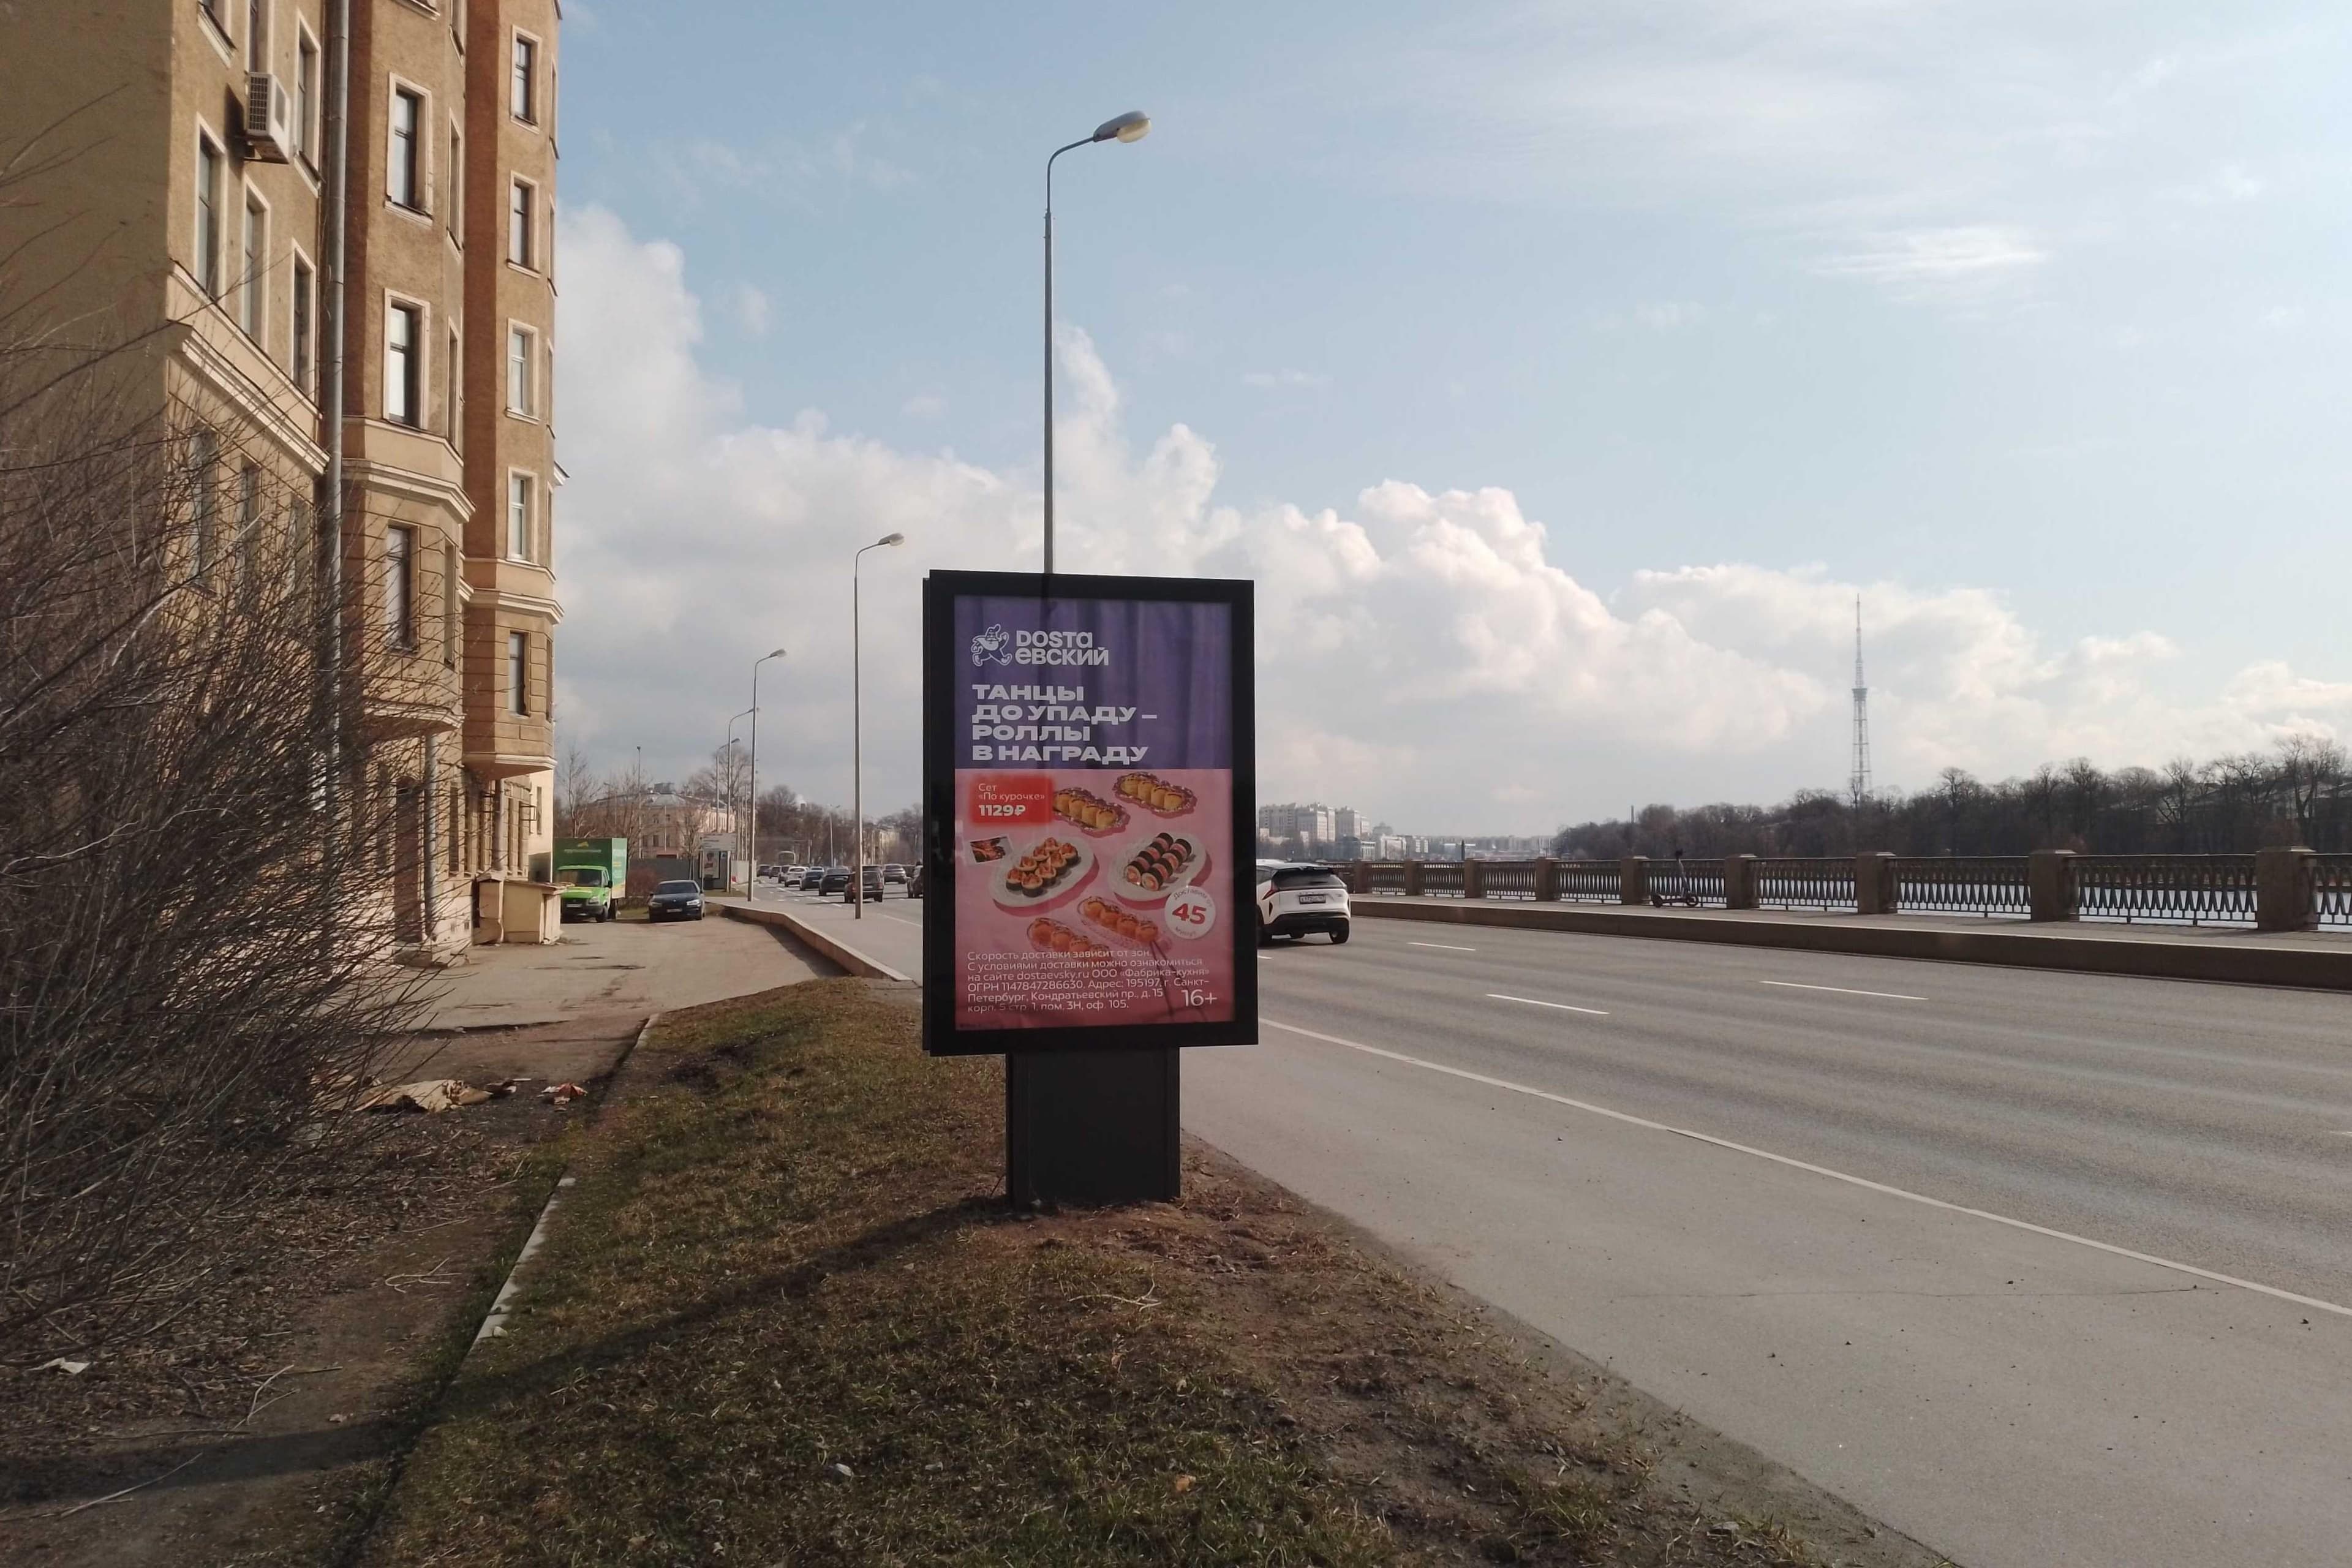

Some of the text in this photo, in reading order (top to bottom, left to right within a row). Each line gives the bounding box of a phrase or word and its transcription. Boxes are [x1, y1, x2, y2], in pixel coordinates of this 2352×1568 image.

[971, 684, 1084, 704] ТАНЦЫ
[971, 705, 1023, 723] ДО
[1027, 706, 1137, 725] УПАДУ
[972, 725, 1090, 741] РОЛЛЫ
[972, 745, 1149, 765] В НАГРАДУ
[978, 783, 998, 791] Сет
[978, 792, 1046, 802] «По курочке»
[1172, 903, 1207, 925] 45
[967, 951, 1019, 961] Скорость
[1021, 951, 1070, 960] доставки
[1072, 950, 1114, 959] зависит
[967, 962, 976, 971] С
[978, 962, 1038, 973] условиями
[1039, 961, 1089, 970] доставки
[1130, 959, 1202, 967] ознакомиться
[983, 972, 1014, 981] сайте
[1017, 971, 1090, 983] dostaevsky.ru
[1091, 969, 1117, 978] ООО
[968, 982, 999, 992] ОГРН
[1031, 990, 1119, 1001] Кондратьевский
[1180, 989, 1218, 1008] 16+
[1109, 999, 1129, 1009] 105.
